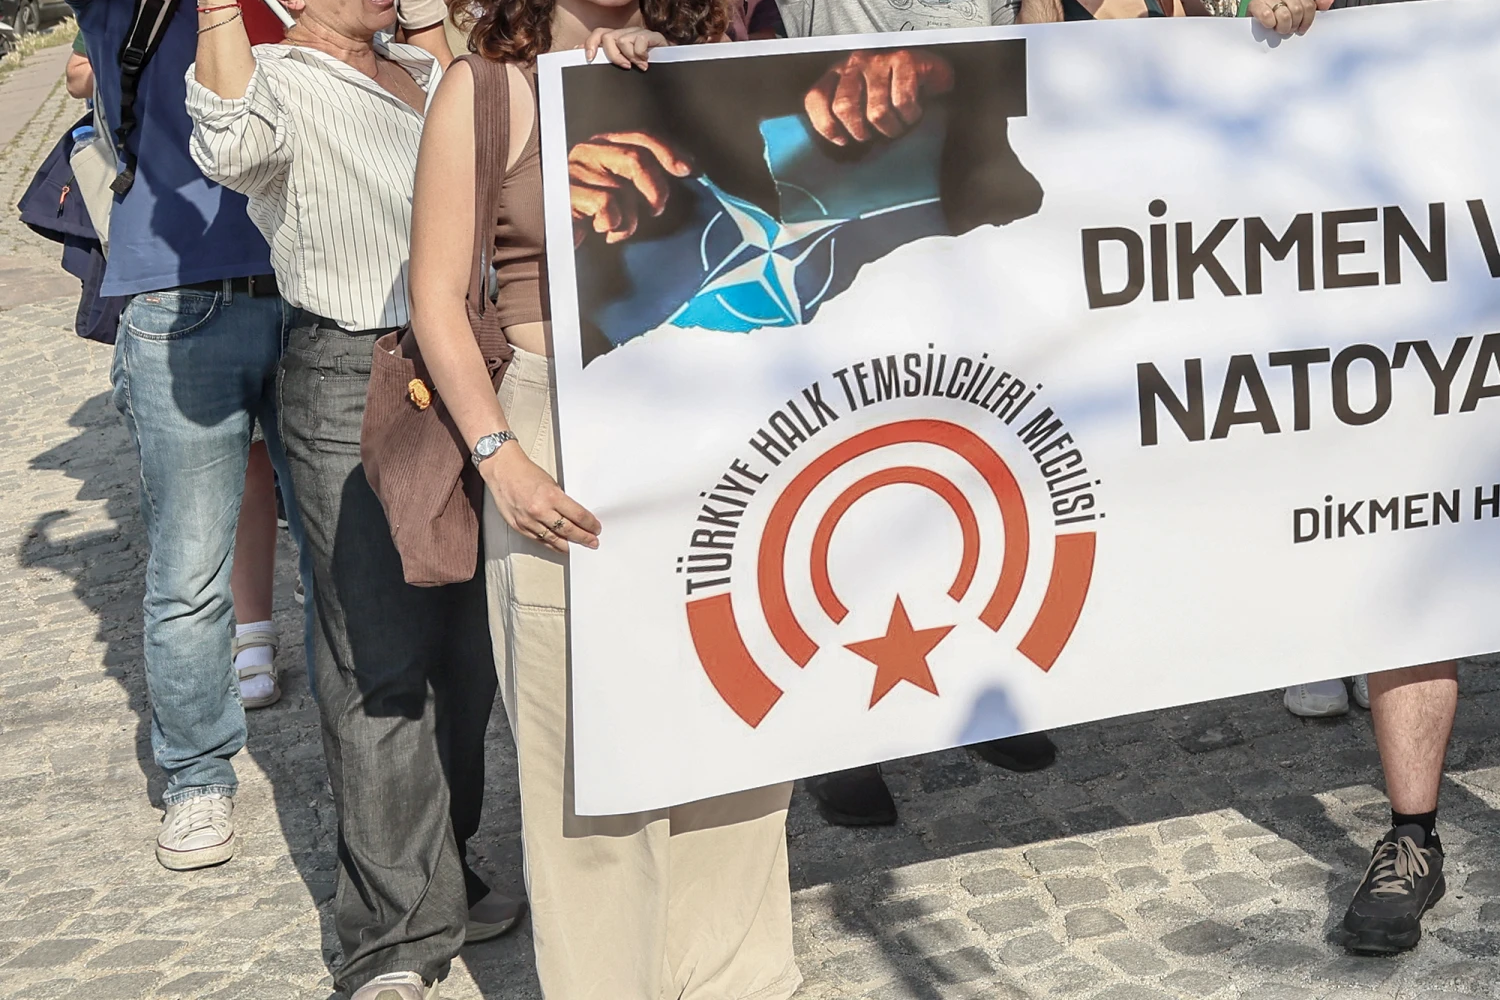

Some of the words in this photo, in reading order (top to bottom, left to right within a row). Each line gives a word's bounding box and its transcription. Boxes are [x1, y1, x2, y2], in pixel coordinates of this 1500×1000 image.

[1080, 198, 1448, 310] DİKMEN
[676, 457, 769, 596] TÜRKİYE
[748, 381, 840, 467] HALK
[832, 342, 1043, 426] TEMSİLCİLERİ
[1016, 406, 1106, 527] MECLİSİ
[1293, 488, 1461, 545] DİKMEN
